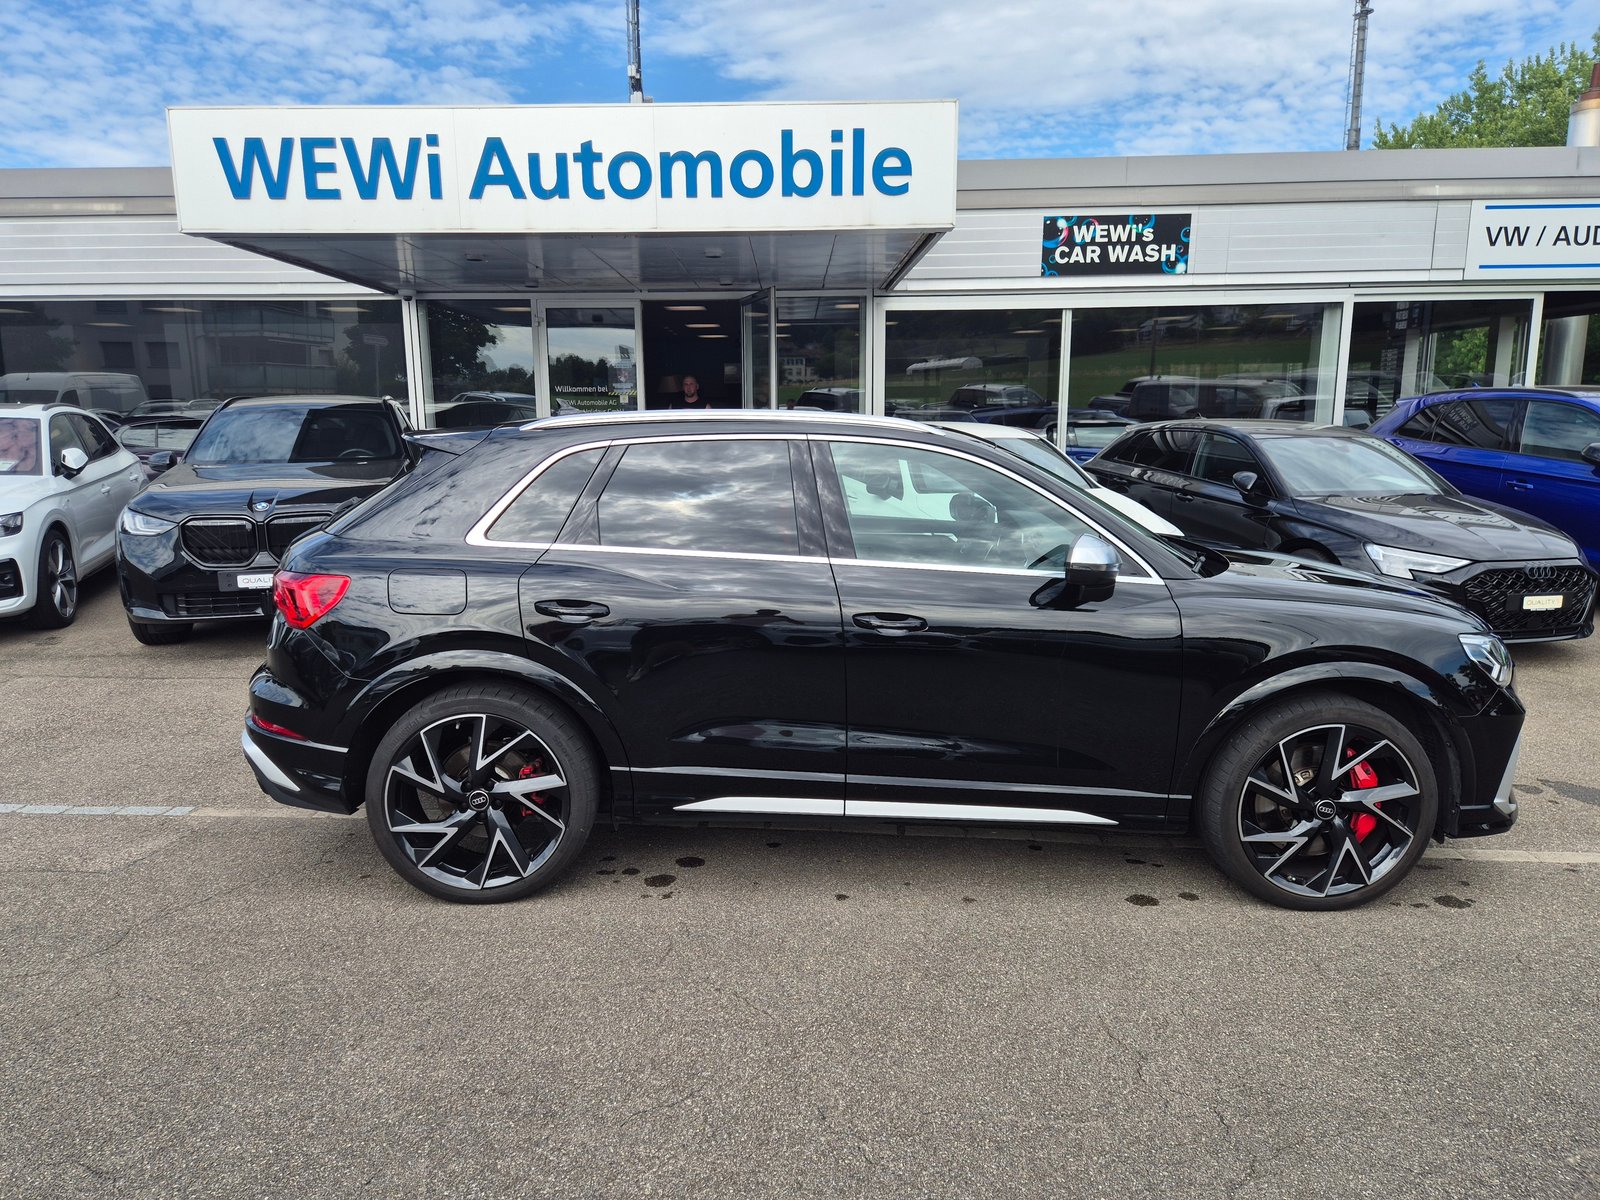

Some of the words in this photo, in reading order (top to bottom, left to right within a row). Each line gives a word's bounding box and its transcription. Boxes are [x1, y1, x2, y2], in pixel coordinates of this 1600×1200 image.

[212, 133, 443, 201] WEWi
[468, 127, 912, 201] Automobile
[1072, 223, 1155, 243] WEWi's
[1485, 225, 1531, 247] VW
[1535, 225, 1547, 247] /
[1054, 245, 1101, 265] CAR
[1107, 243, 1177, 263] WASH
[554, 385, 597, 393] Willkommen
[597, 385, 609, 393] bei
